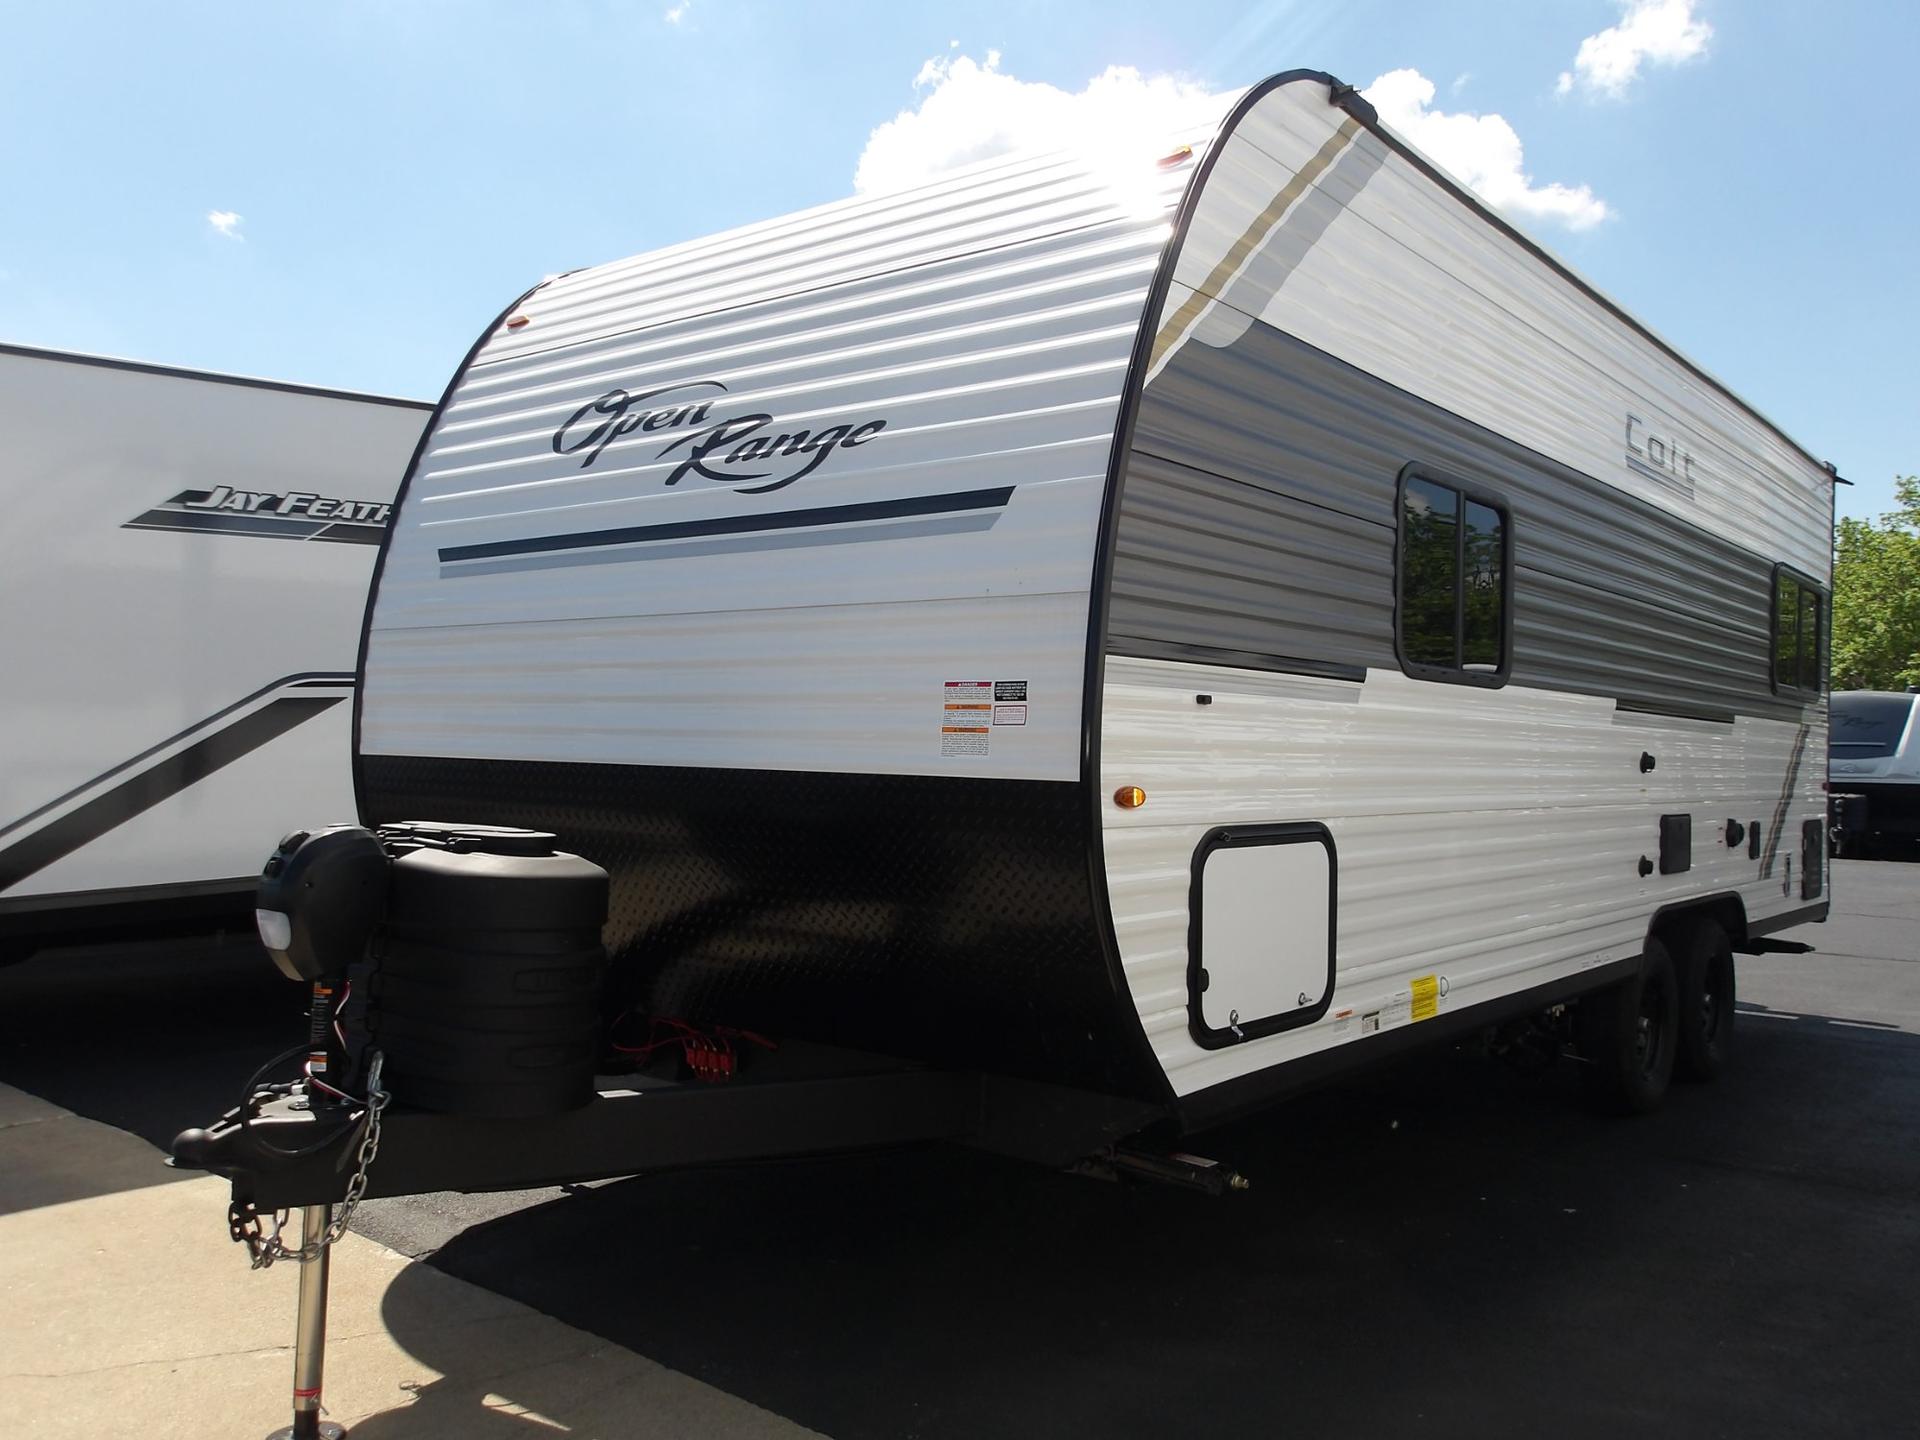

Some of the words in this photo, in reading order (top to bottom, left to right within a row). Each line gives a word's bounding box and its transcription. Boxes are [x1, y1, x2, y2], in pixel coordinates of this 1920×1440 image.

[552, 380, 728, 469] Open
[655, 413, 887, 494] Range
[184, 485, 274, 512] JAY
